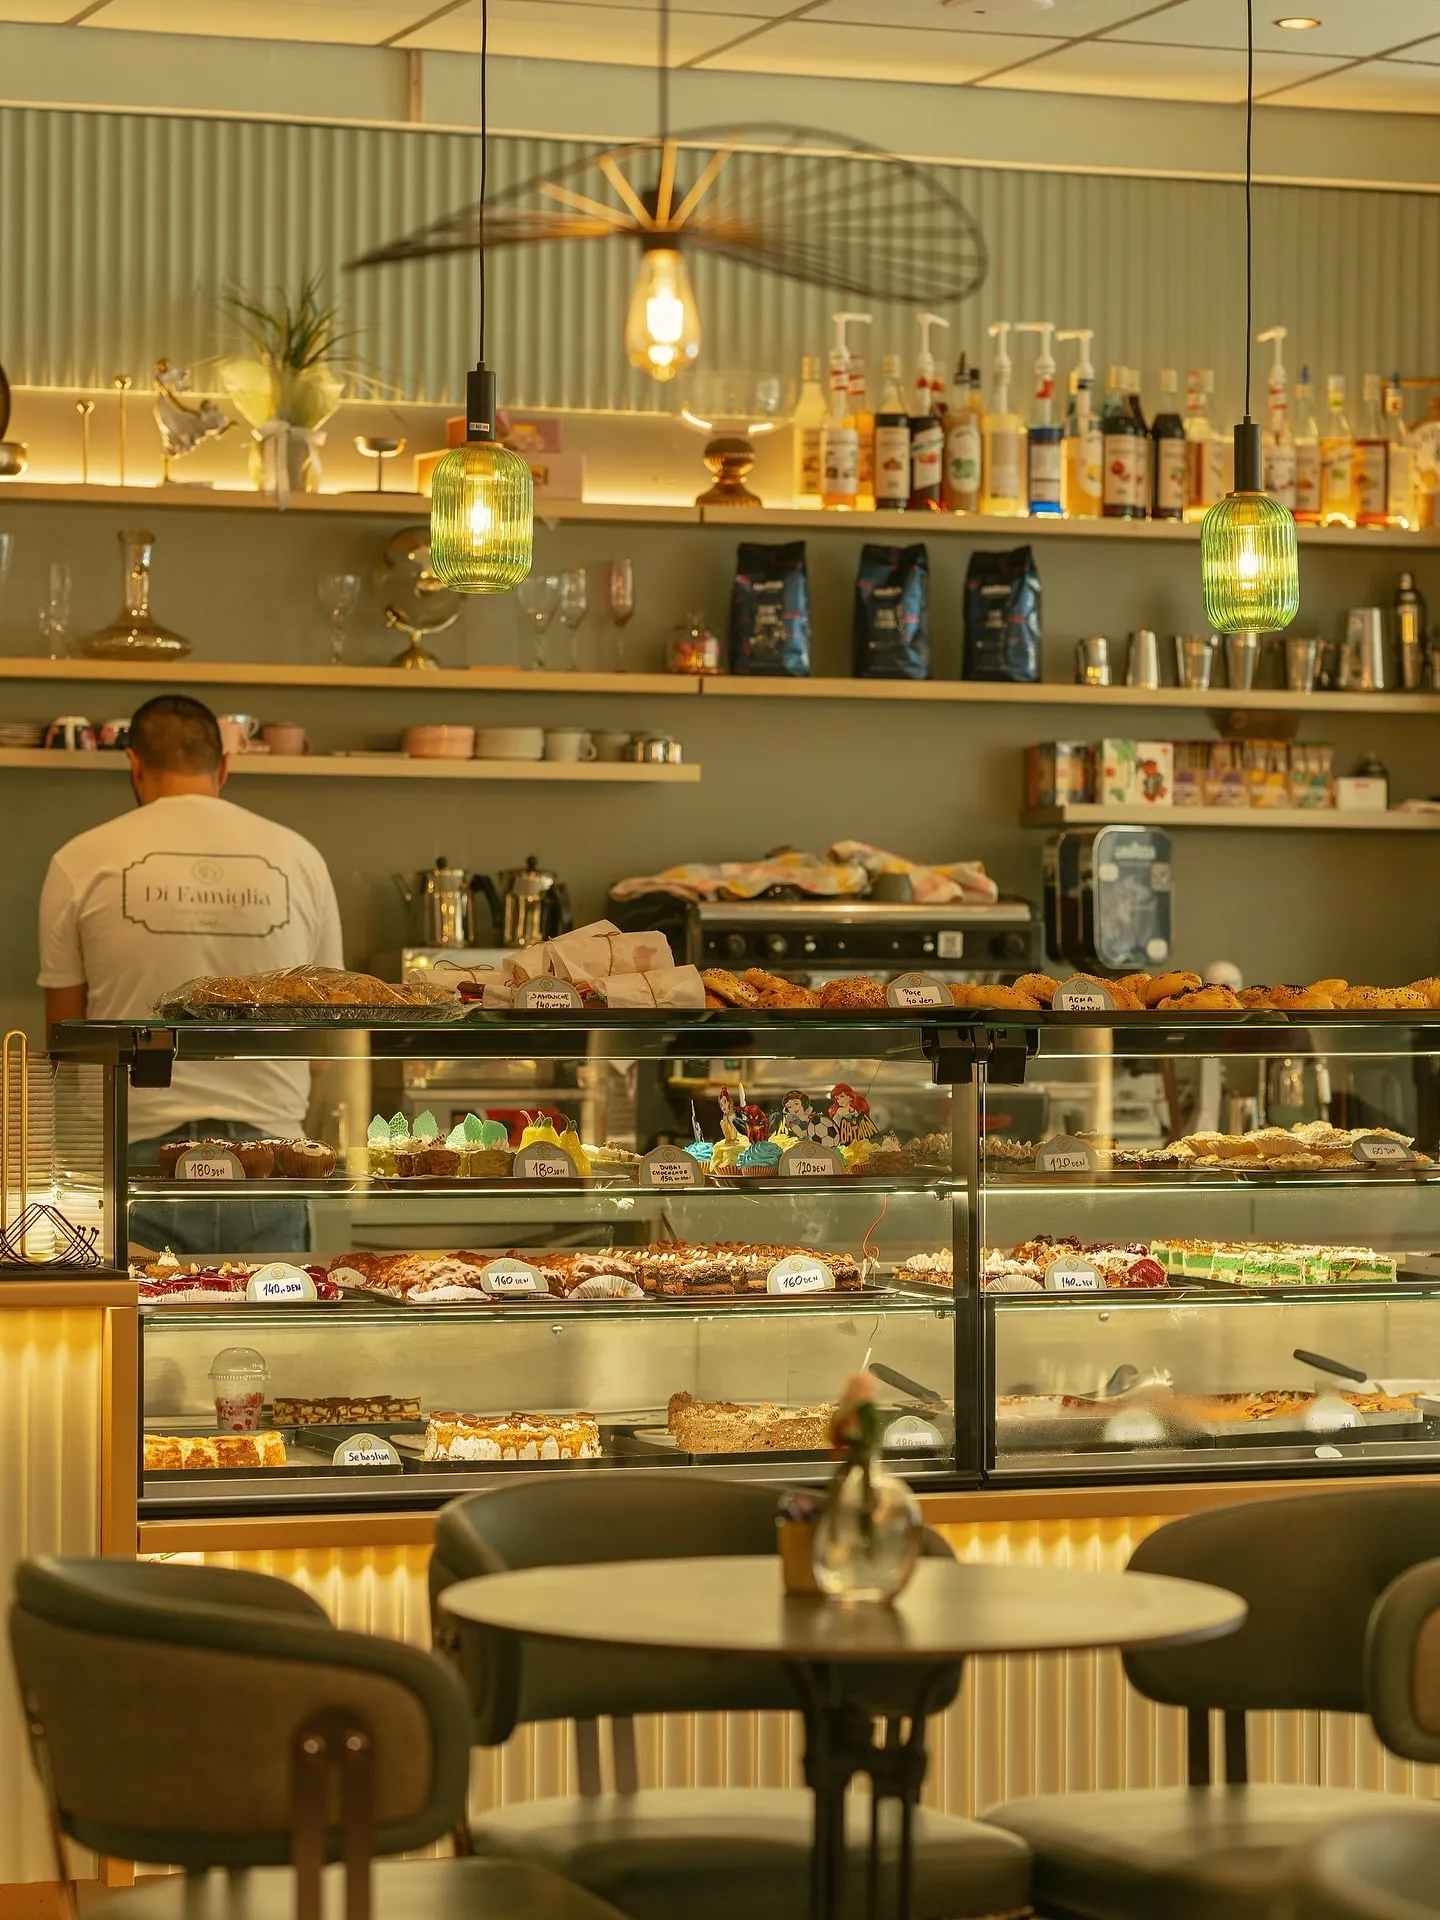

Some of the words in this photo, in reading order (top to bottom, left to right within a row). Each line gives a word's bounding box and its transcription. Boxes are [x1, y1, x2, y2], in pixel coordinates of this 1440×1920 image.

[178, 885, 272, 910] Famiglia
[782, 1275, 803, 1288] 160
[286, 1284, 302, 1293] DEN
